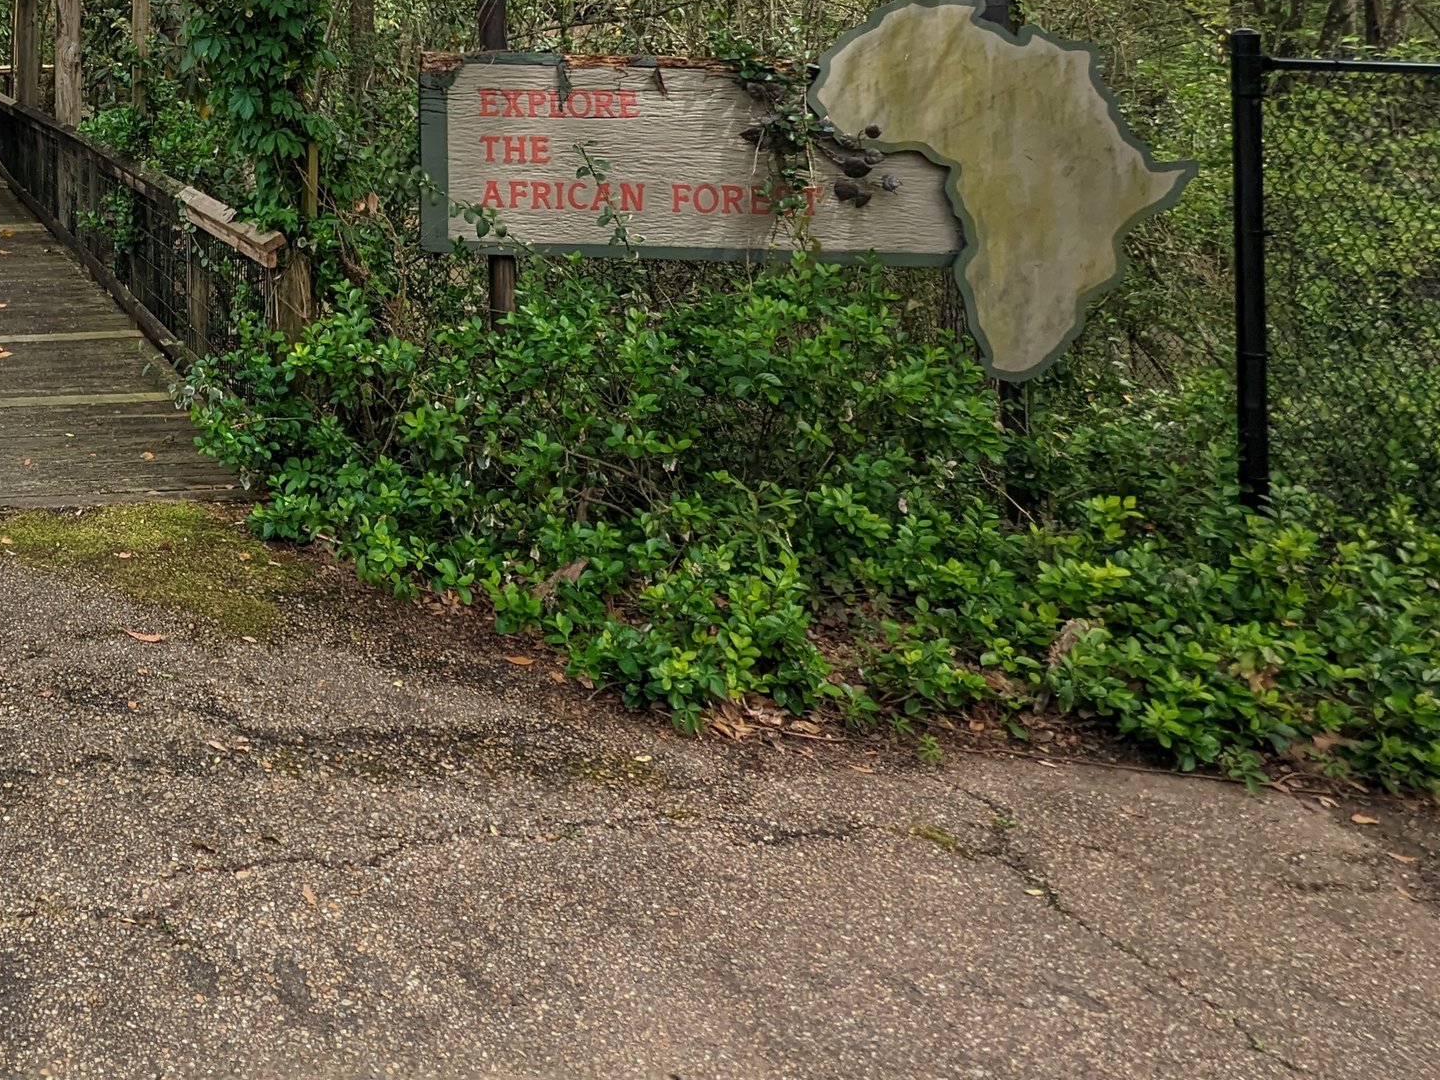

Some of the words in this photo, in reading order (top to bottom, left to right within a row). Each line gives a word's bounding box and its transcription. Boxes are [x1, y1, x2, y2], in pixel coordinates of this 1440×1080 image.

[478, 89, 641, 119] EXPLORE
[479, 135, 551, 164] THE
[482, 180, 646, 212] AFRICAN
